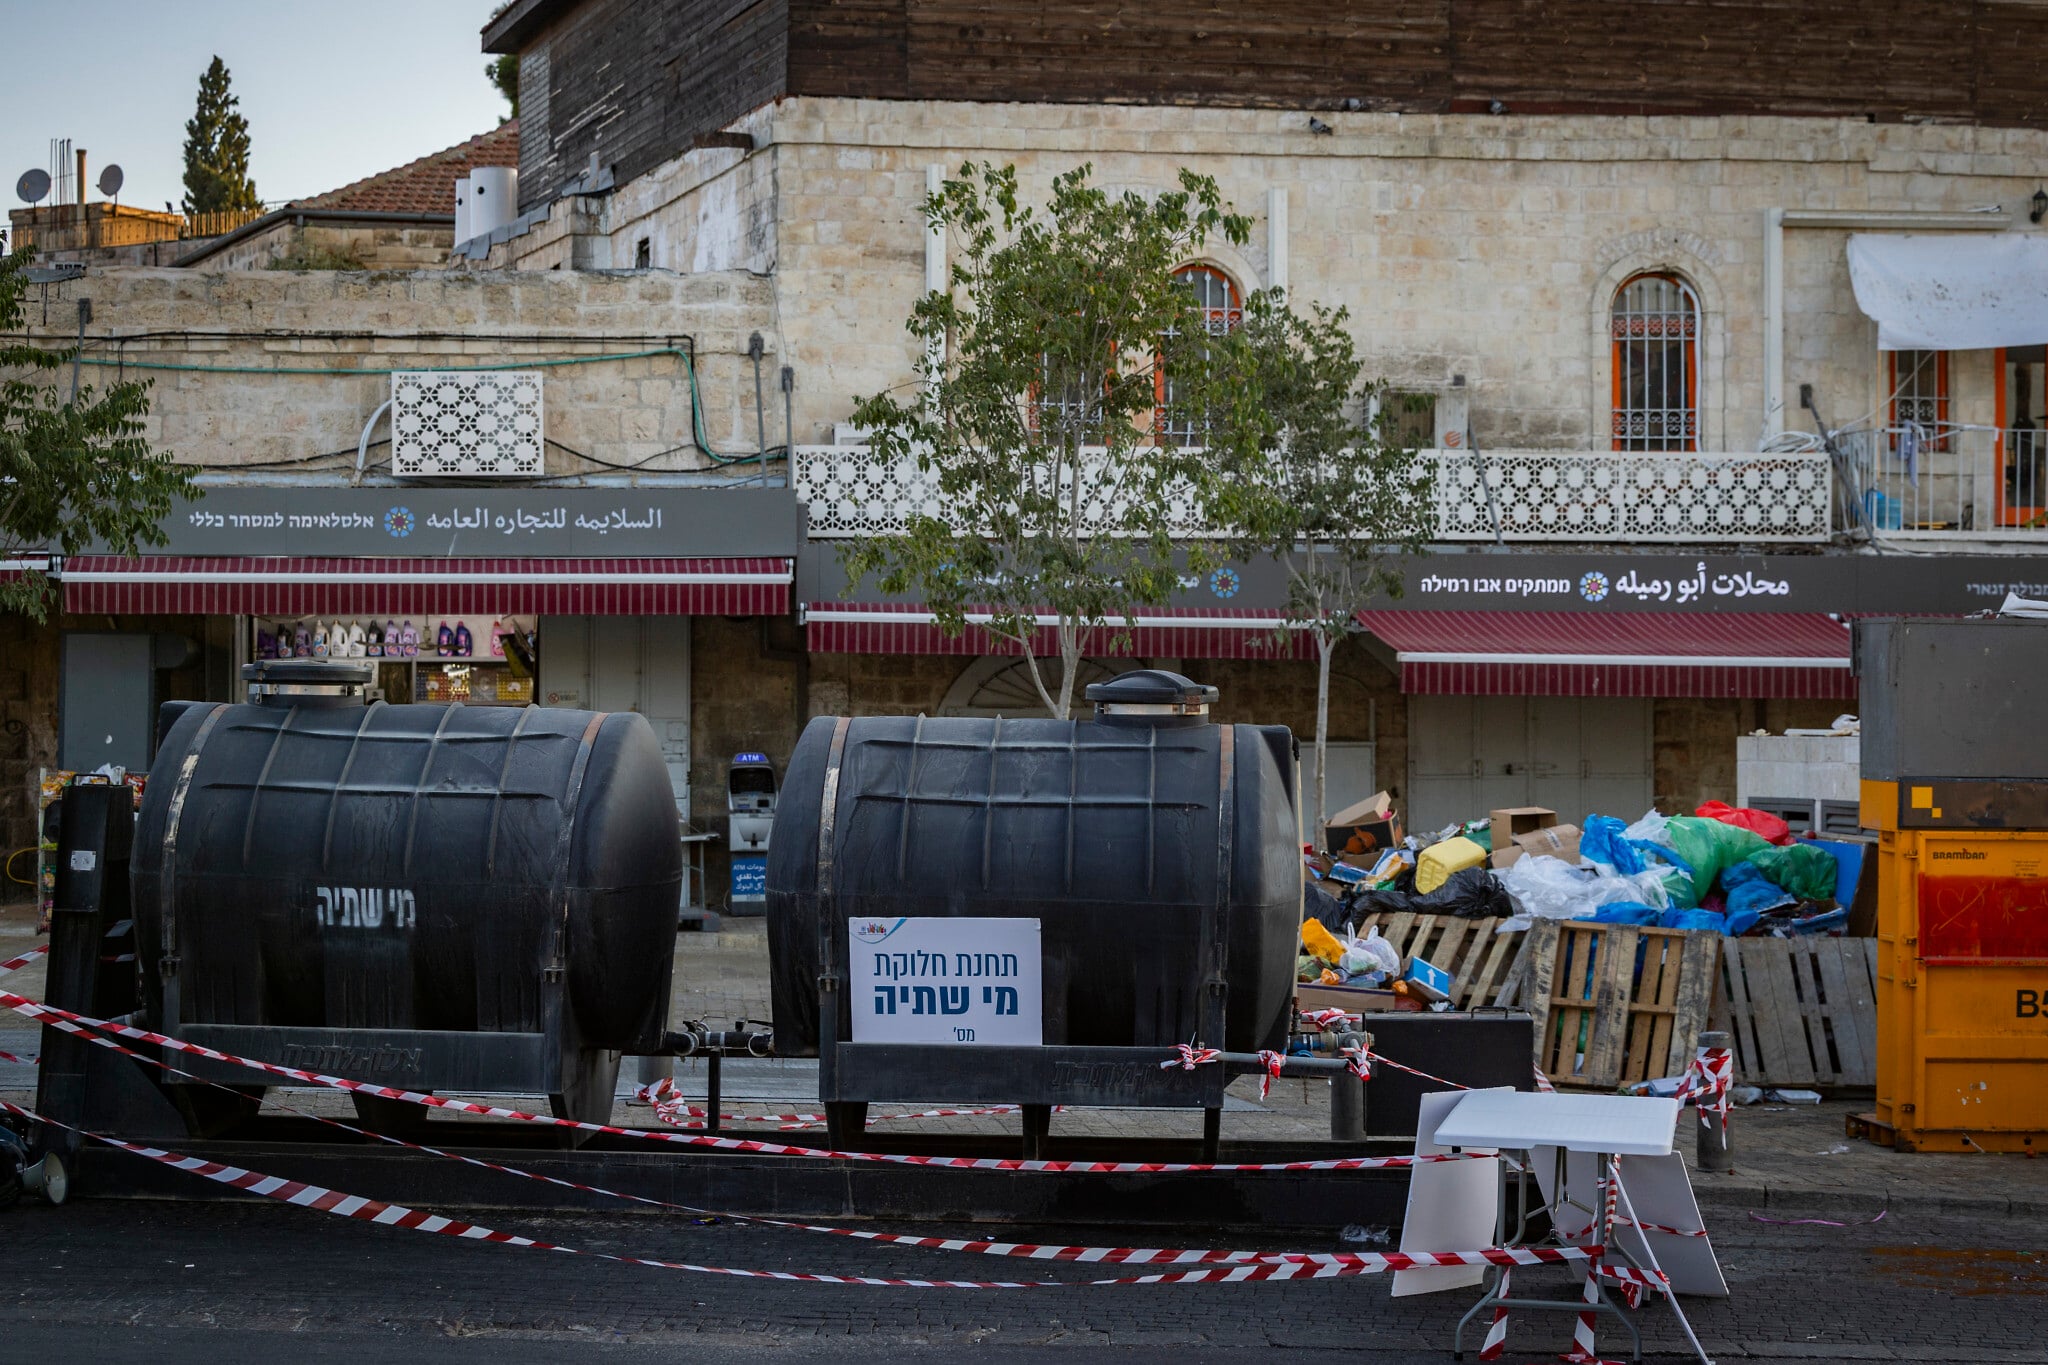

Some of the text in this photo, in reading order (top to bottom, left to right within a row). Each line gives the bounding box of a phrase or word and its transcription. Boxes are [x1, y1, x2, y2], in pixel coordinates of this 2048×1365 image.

[188, 510, 374, 529] אלסלאימה למסחר כללי
[426, 507, 489, 530] العامه
[494, 507, 567, 536] للتجاره
[1420, 573, 1572, 597] ממתקים אבו רמילה
[1615, 561, 1791, 604] محلات أبو رميله
[742, 754, 760, 762] ATM
[316, 886, 416, 928] מי שתיה
[873, 949, 1018, 981] תחנת חלוקת
[874, 985, 1019, 1016] מי שתיה
